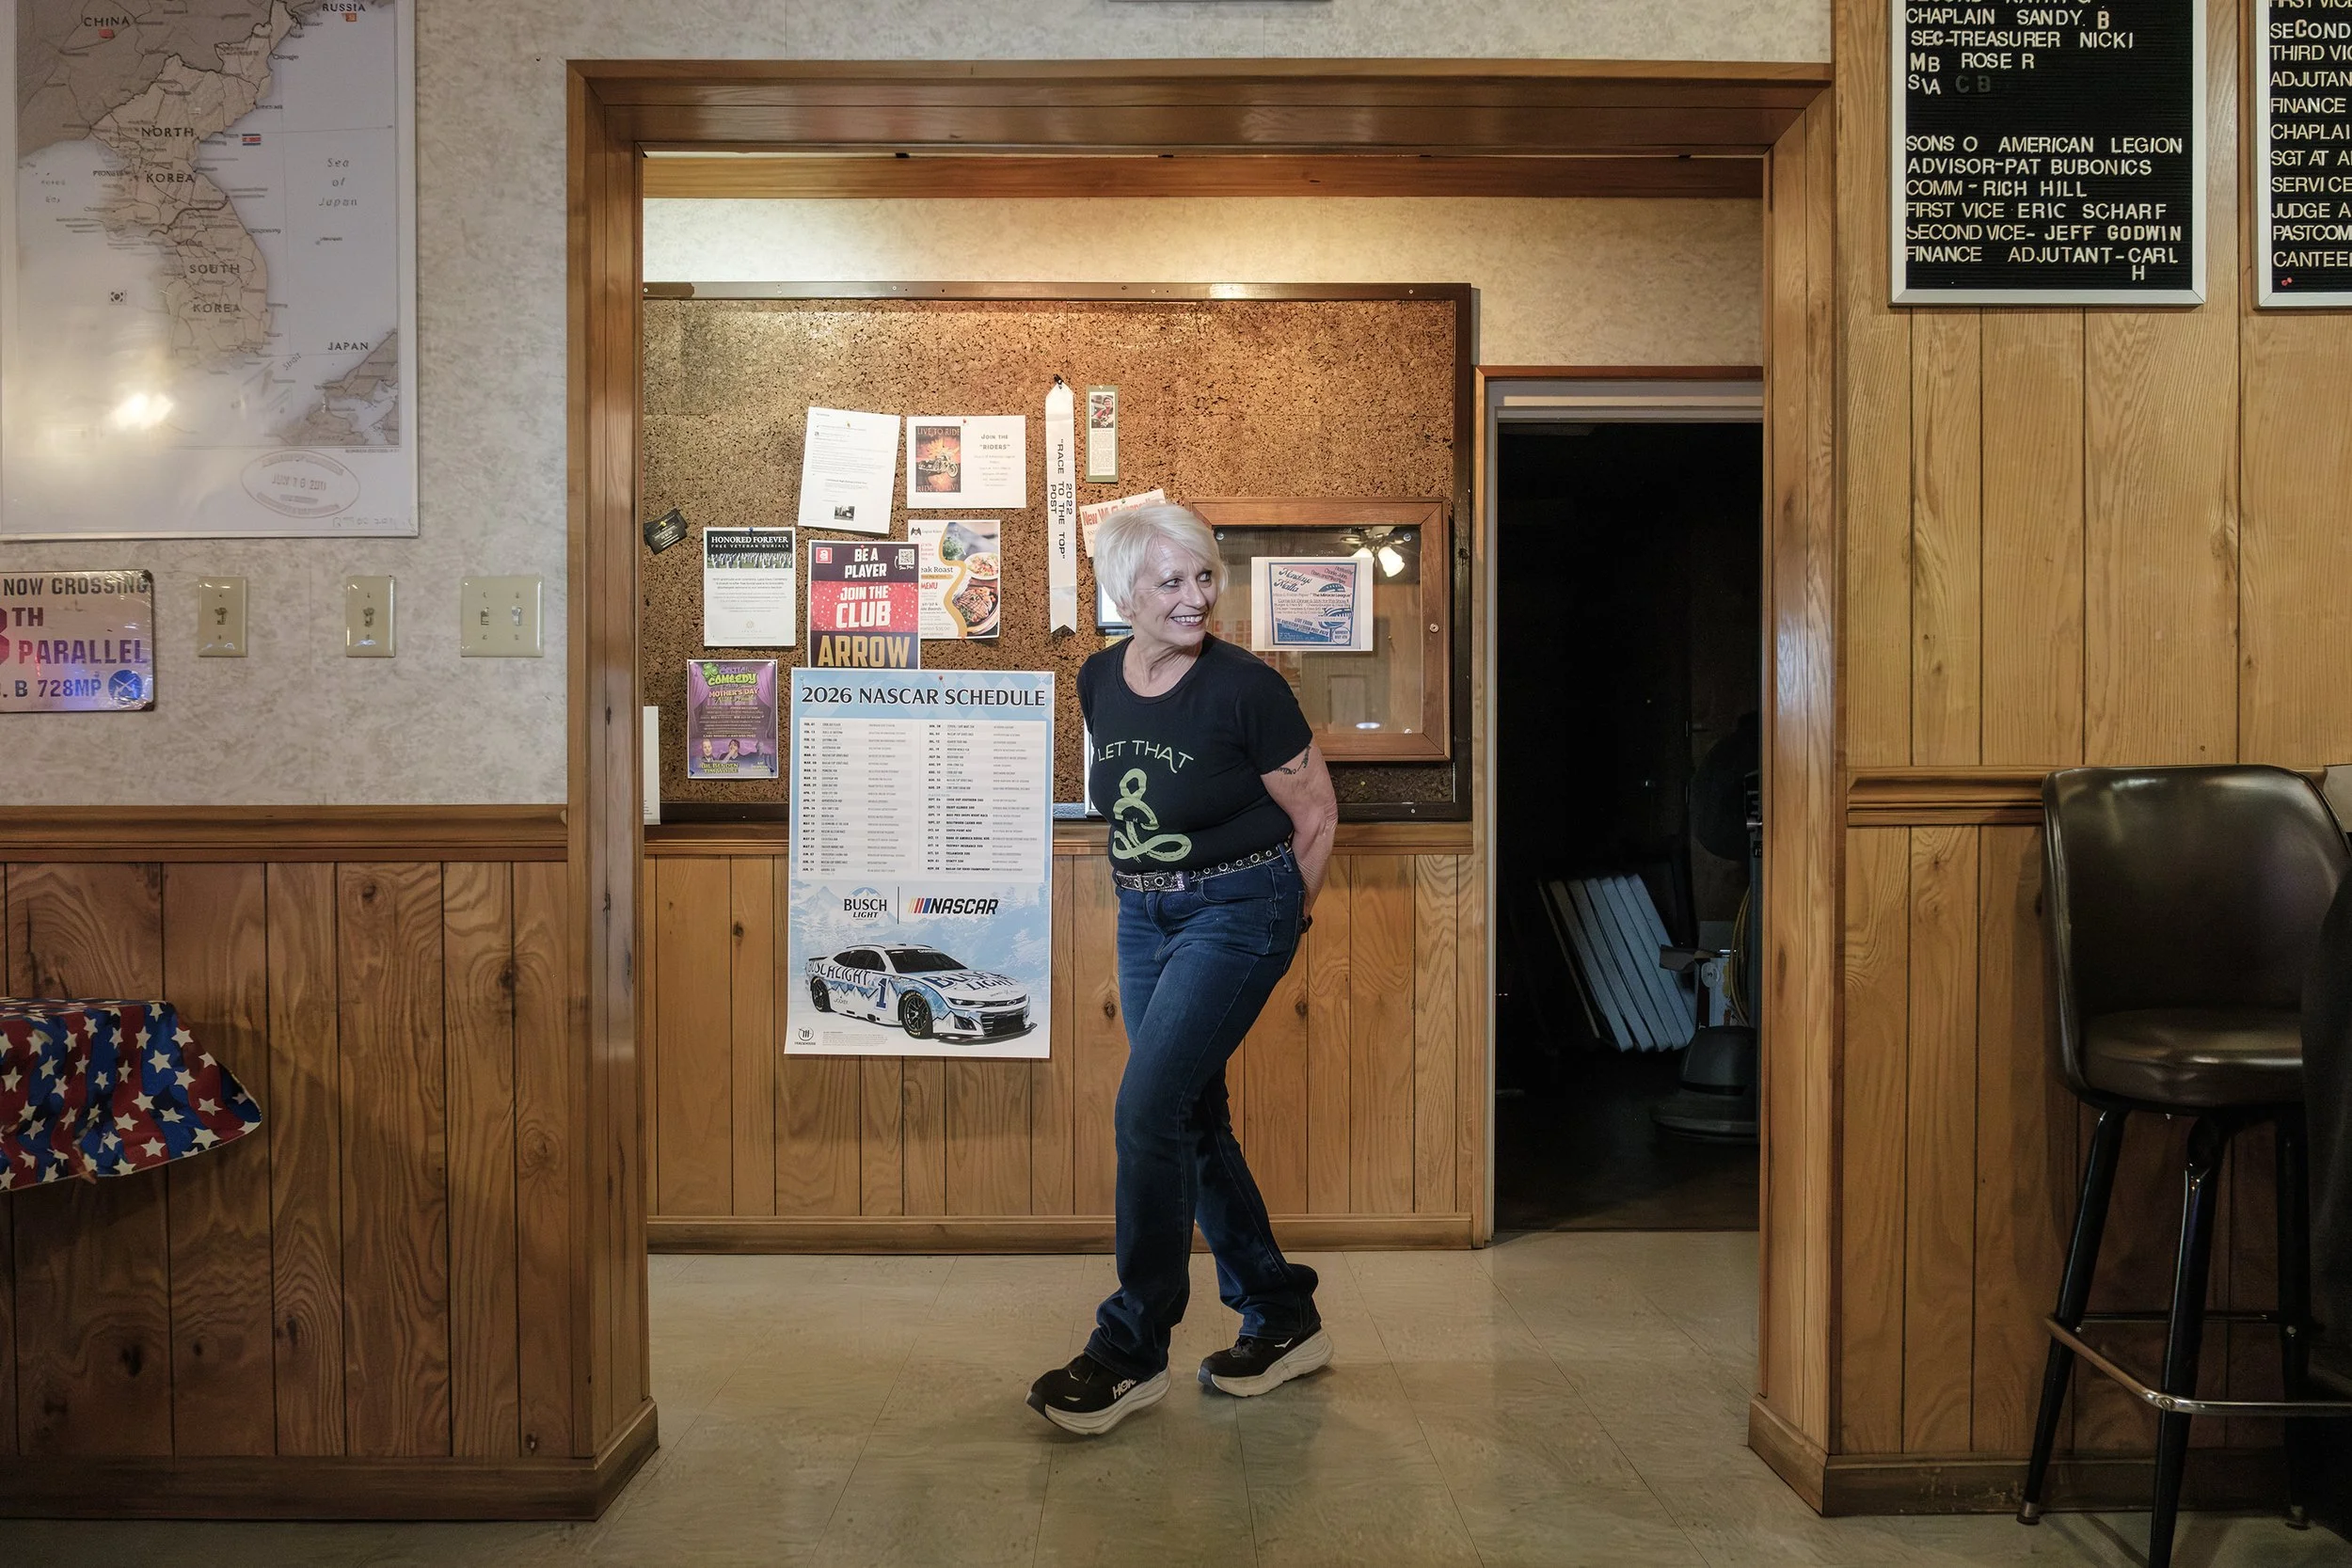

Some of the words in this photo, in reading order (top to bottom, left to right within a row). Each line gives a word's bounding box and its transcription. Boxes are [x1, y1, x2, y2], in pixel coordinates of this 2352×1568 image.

[322, 3, 366, 12] RUSSIA
[83, 16, 130, 27] CHINA
[1906, 8, 1995, 25] CHAPLAIN
[2097, 10, 2109, 30] B
[2270, 19, 2351, 40] SECOND
[1911, 31, 2060, 47] SEC-TREASURER
[2079, 32, 2134, 49] NICKI
[2269, 44, 2325, 61] THIRD
[1961, 53, 2012, 70] ROSE
[2022, 54, 2035, 70] R
[2270, 98, 2346, 114] FINANCE
[141, 127, 194, 137] NORTH
[2270, 124, 2350, 140] CHAPLAI
[1906, 135, 1955, 152] SONS
[1963, 135, 1979, 153] O
[1998, 136, 2094, 153] AMERICAN
[2111, 137, 2182, 154] LEGION
[327, 158, 349, 167] Sea
[2270, 150, 2306, 166] SGT
[2308, 150, 2329, 166] AT
[2051, 159, 2153, 176] BUBONICS
[146, 173, 195, 182] KOREA
[332, 177, 345, 186] of
[1906, 180, 1963, 196] COMM
[1983, 181, 2026, 197] RICH
[2040, 181, 2088, 197] HILL
[318, 198, 358, 208] Japan
[1906, 202, 1954, 218] FIRST
[1962, 202, 2005, 218] VICE
[2017, 202, 2067, 219] ERIC
[2082, 203, 2167, 220] SCHARF
[2271, 202, 2330, 219] JUDGE
[1906, 224, 1983, 241] SECOND
[2044, 225, 2096, 241] JEFF
[2107, 225, 2182, 242] GODWIN
[1906, 245, 1982, 262] FINANCE
[2272, 251, 2352, 267] CANTEE
[189, 264, 240, 274] SOUTH
[2132, 265, 2145, 281] H
[193, 304, 241, 312] KOREA
[327, 342, 369, 351] JAPAN
[1057, 482, 1065, 496] TO
[854, 548, 868, 562] BE
[870, 547, 879, 562] A
[845, 563, 887, 578] PLAYER
[4, 578, 43, 595] NOW
[52, 577, 149, 594] CROSSING
[840, 586, 866, 601] JOIN
[868, 585, 889, 599] THE
[835, 601, 892, 628] CLUB
[19, 640, 148, 664] PARALLEL
[818, 635, 911, 668] ARROW
[707, 673, 757, 686] COMEDY
[15, 680, 28, 698] B
[38, 678, 102, 698] 728MP
[708, 689, 742, 698] MOTHER'S
[802, 687, 852, 704] 2026
[859, 688, 939, 705] NASCAR
[945, 689, 1045, 705] SCHEDULE
[1098, 741, 1126, 762] LET
[1132, 740, 1194, 773] THAT
[844, 898, 887, 911] BUSCH
[929, 897, 999, 914] NASCAR
[876, 977, 887, 1009] 1
